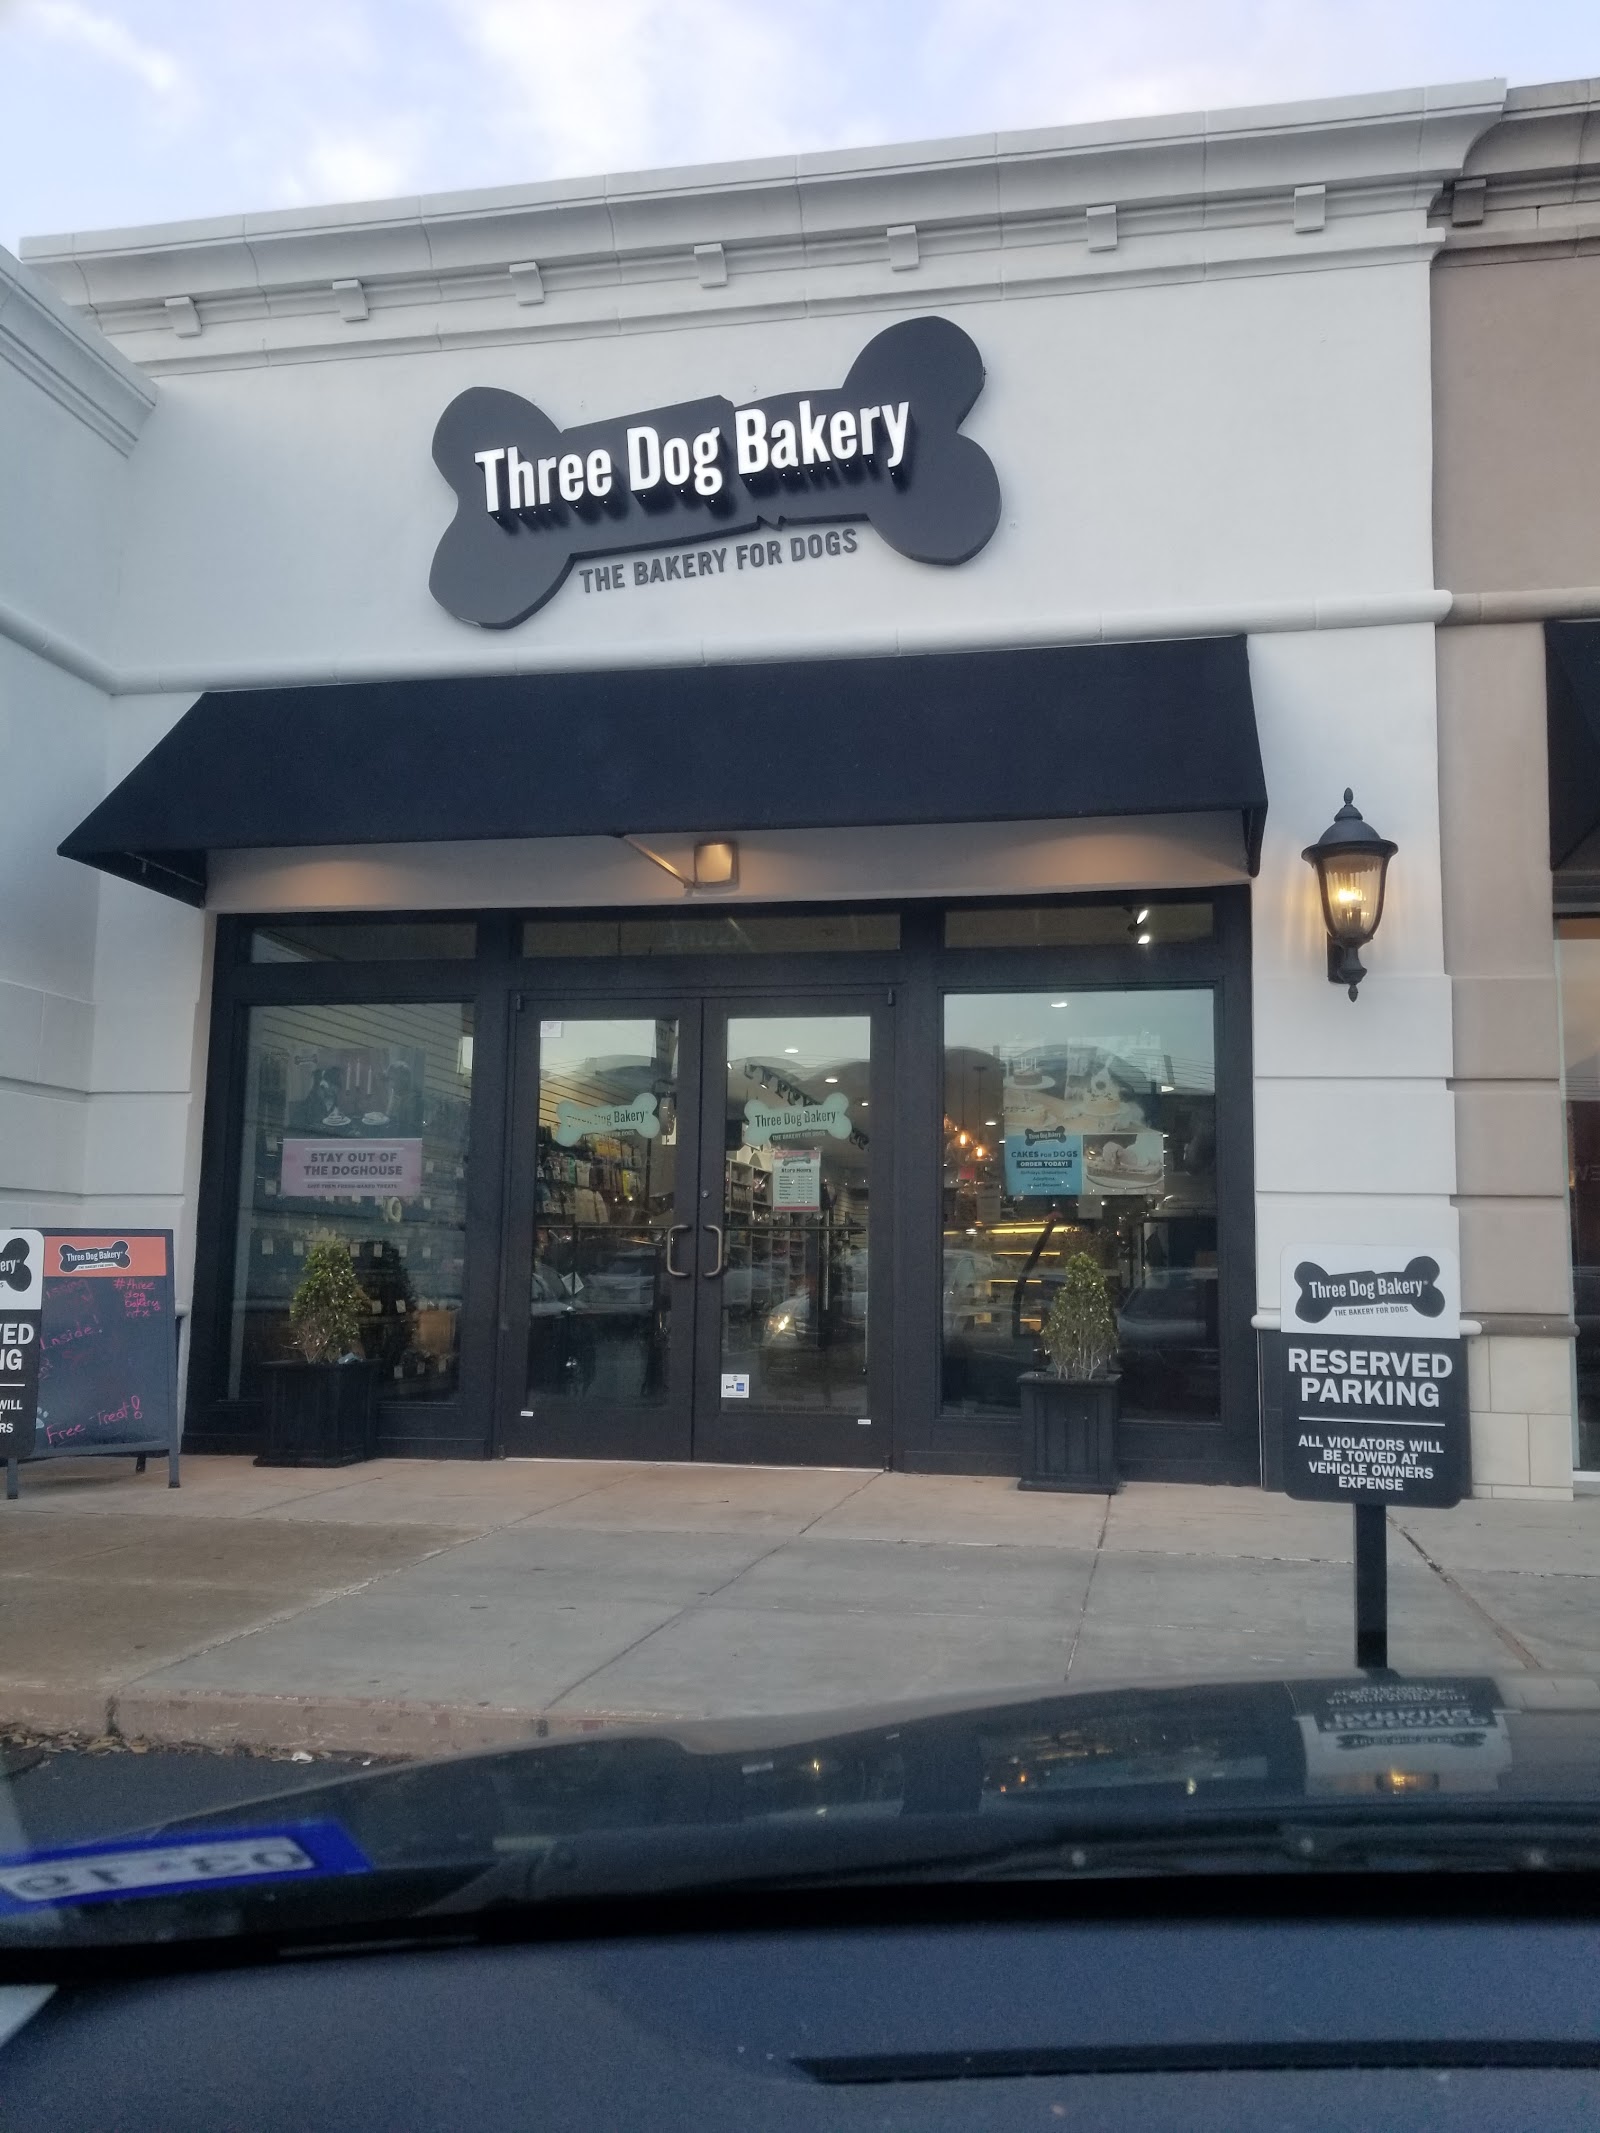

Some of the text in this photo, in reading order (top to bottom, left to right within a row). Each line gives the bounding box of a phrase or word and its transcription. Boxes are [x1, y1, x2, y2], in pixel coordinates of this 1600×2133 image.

[475, 400, 910, 513] Three Dog Bakery
[579, 529, 858, 594] THE BAKERY FOR DOGS
[614, 1110, 645, 1123] Bakery
[755, 1110, 836, 1127] Three Dog Bakery
[311, 1152, 398, 1163] STAY OUT OF
[1053, 1150, 1078, 1158] DOGS
[303, 1165, 403, 1176] THE DOGHOUSE
[66, 1250, 121, 1262] Three Dog Bakery
[1309, 1277, 1423, 1300] Three Dog Bakery
[1348, 1307, 1374, 1316] BAKERY
[1376, 1306, 1389, 1314] FOR
[1390, 1305, 1409, 1313] DOGS
[1288, 1348, 1453, 1378] RESERVED
[1300, 1377, 1440, 1408] PARKING
[46, 1395, 143, 1444] Free Treat!
[1298, 1435, 1444, 1454] ALL VIOLATORS WILL
[1323, 1449, 1418, 1465] BE TOWED AT
[1308, 1461, 1434, 1480] VEHICLE OWNERS
[1338, 1476, 1404, 1491] EXPENSE
